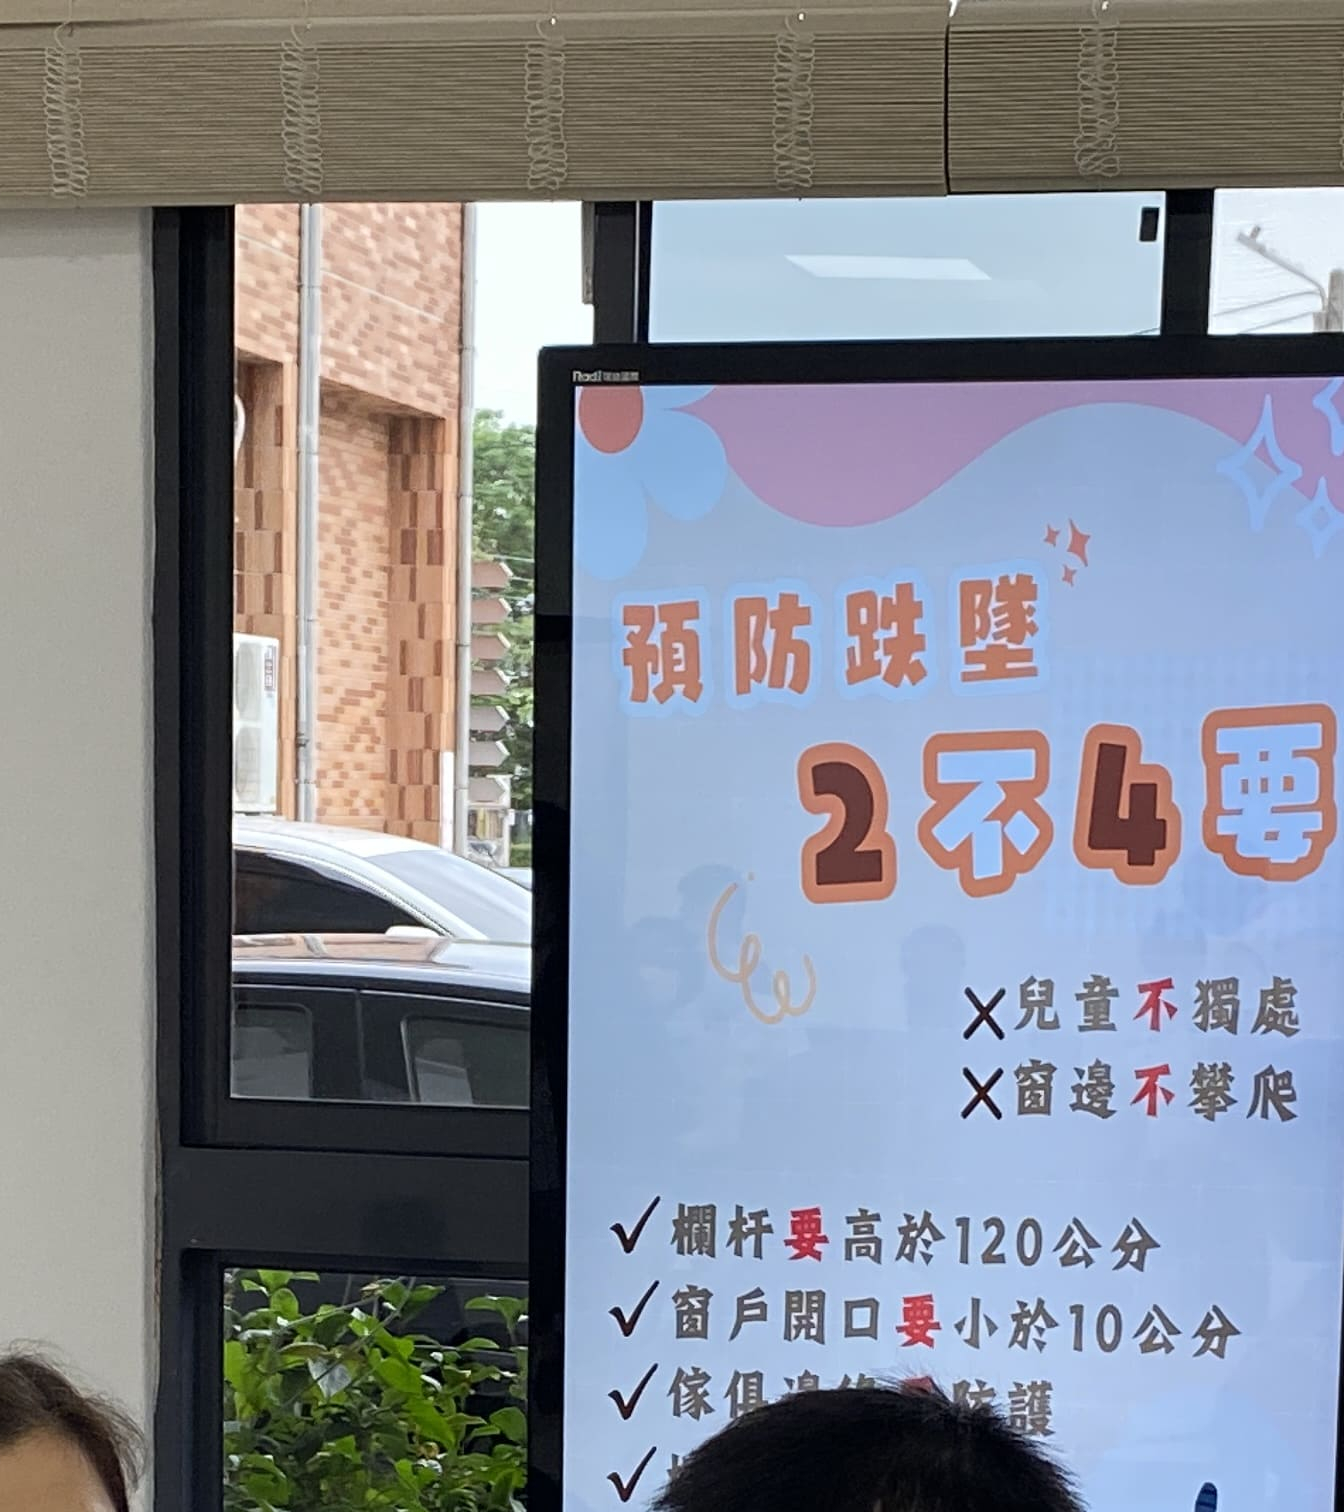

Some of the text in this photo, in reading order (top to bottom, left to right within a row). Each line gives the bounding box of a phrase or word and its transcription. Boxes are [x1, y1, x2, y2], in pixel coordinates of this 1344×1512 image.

[621, 572, 1040, 706] 預防跌墜
[797, 702, 1337, 905] 2不4要
[1013, 975, 1302, 1037] 兒童不獨處
[1013, 1058, 1299, 1123] 窗邊不攀爬
[670, 1202, 1162, 1274] 欄杆要高於120公分
[671, 1284, 1243, 1361] 窗戶開口要小於10公分
[667, 1365, 1056, 1438] 傢俱防護
